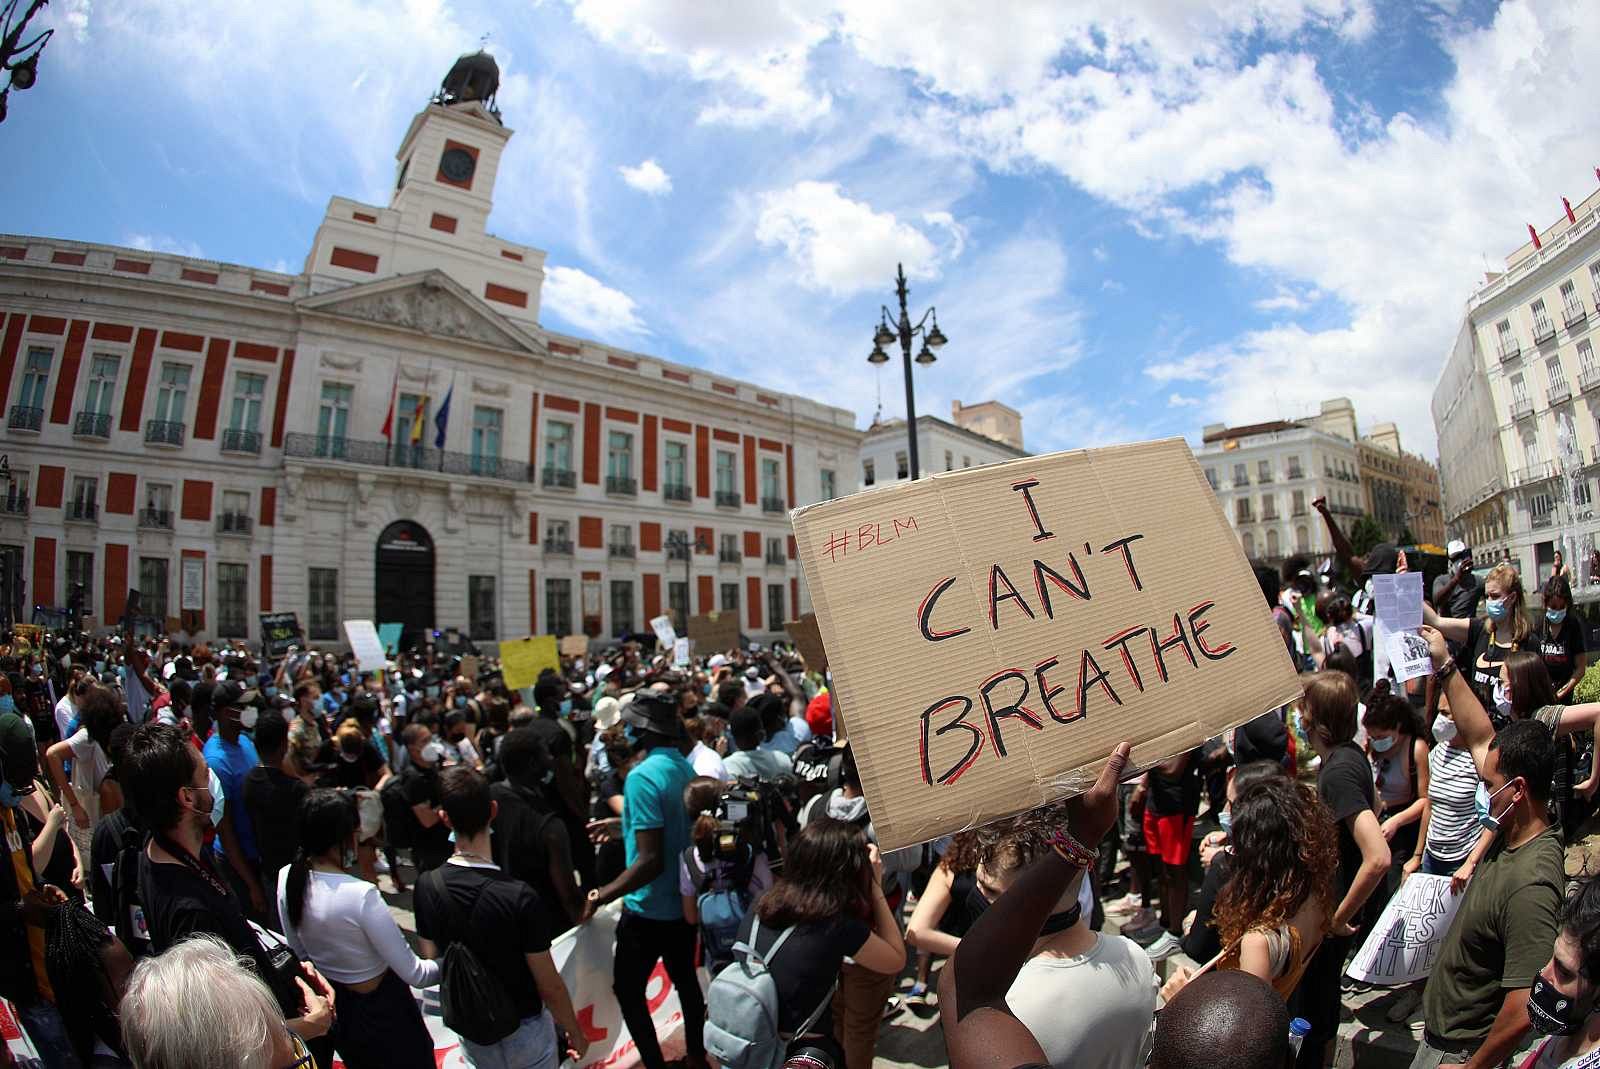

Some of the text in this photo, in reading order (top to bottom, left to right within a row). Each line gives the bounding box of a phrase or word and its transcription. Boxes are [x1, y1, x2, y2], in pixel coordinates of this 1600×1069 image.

[822, 516, 919, 563] #BLM
[1010, 478, 1057, 543] I
[917, 534, 1144, 641] CAN'T
[918, 600, 1238, 786] BREATHE
